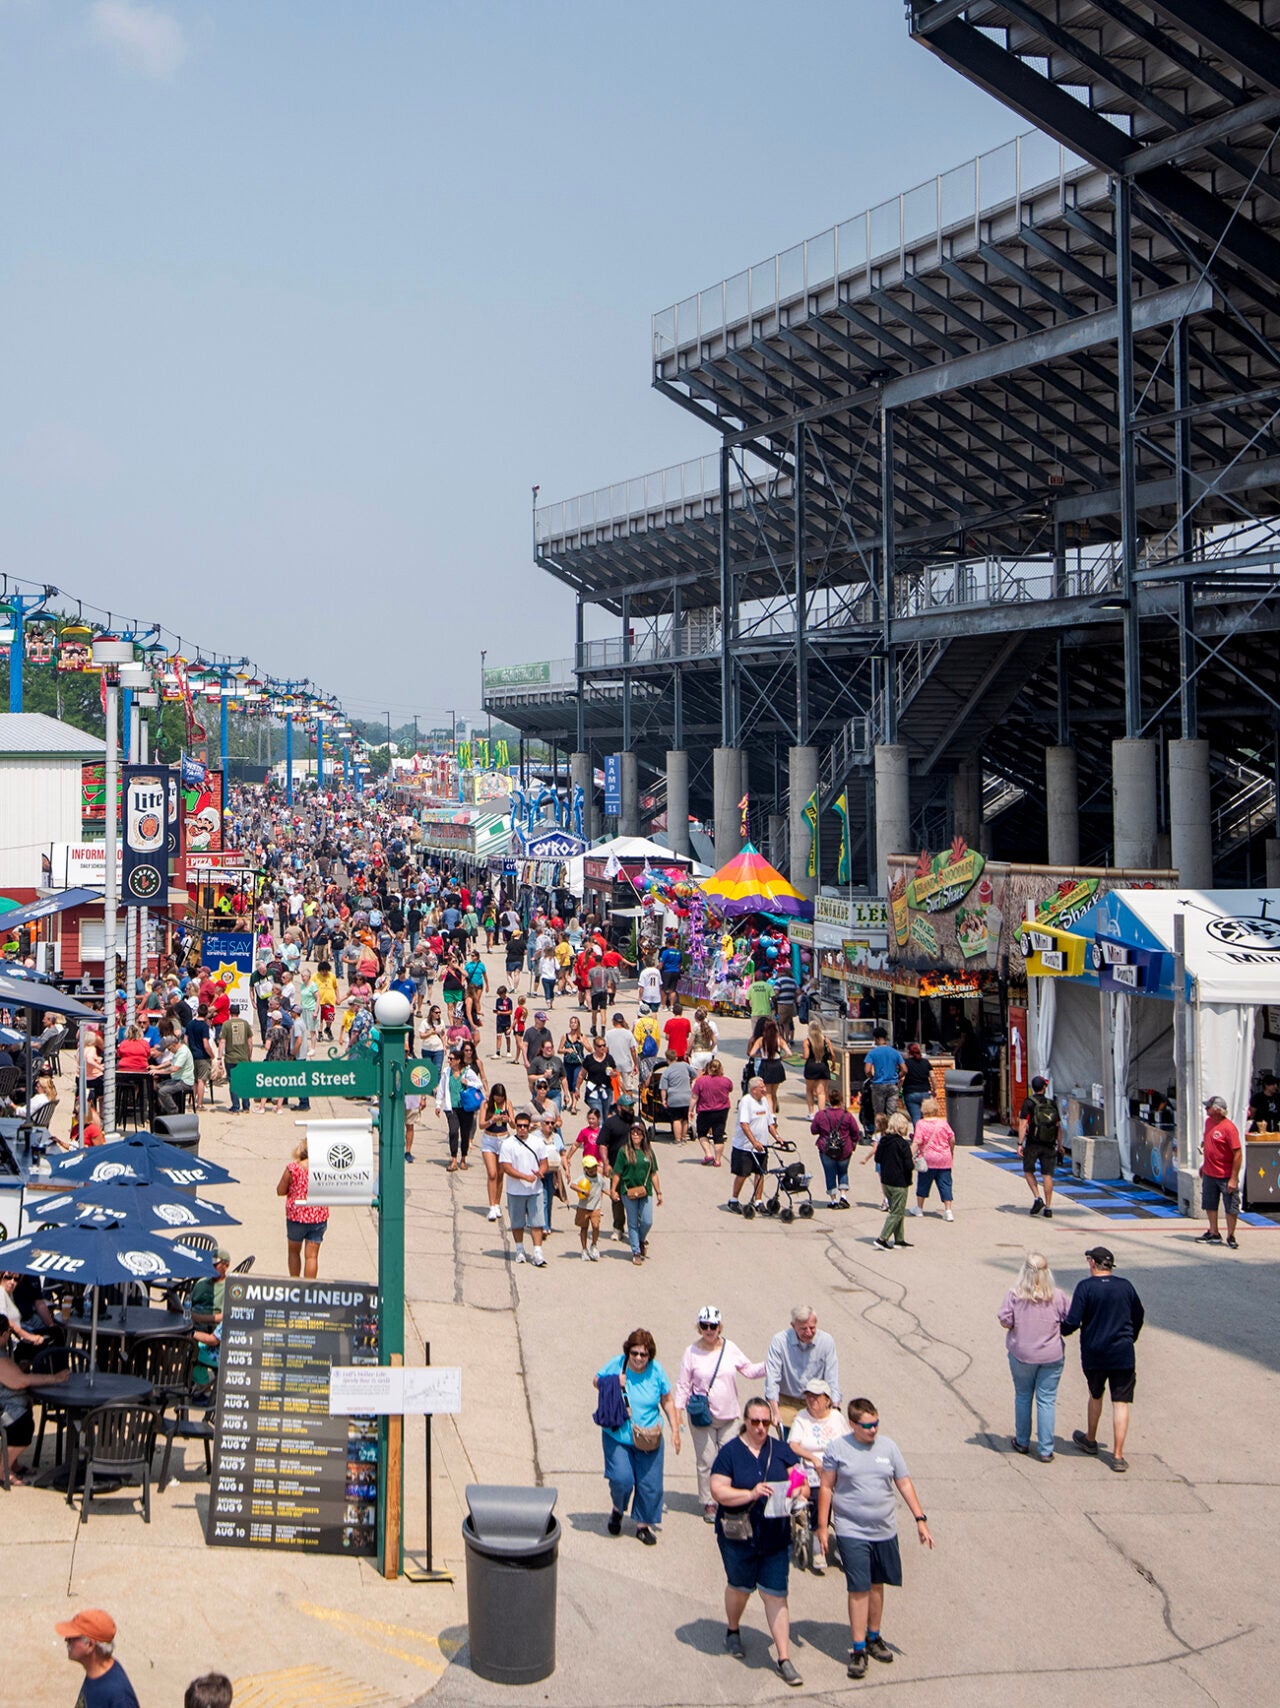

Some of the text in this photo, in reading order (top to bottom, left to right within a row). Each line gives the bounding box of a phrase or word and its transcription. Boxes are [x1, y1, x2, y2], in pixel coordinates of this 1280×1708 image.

[608, 758, 616, 792] RAMP
[134, 792, 162, 812] Lite
[72, 848, 123, 860] INFORMO
[532, 843, 579, 856] GYROS
[191, 858, 212, 866] PIZZA
[944, 861, 974, 880] NOODLES
[926, 884, 965, 914] Surf Shack
[1057, 886, 1088, 910] NOODLES
[816, 900, 849, 922] LEMONADE
[1060, 895, 1100, 929] Shack
[207, 941, 250, 952] SEE SAY
[650, 977, 656, 986] 11
[256, 1072, 356, 1087] Second Street
[165, 1167, 208, 1185] Lite
[312, 1171, 370, 1181] WISCONSIN
[26, 1252, 85, 1272] Lite
[246, 1285, 301, 1303] MUSIC
[304, 1290, 364, 1307] LINEUP
[230, 1311, 255, 1320] JUL 31
[228, 1336, 247, 1344] AUG
[227, 1356, 246, 1365] AUG
[247, 1357, 252, 1366] 2
[225, 1376, 251, 1386] AUG 3
[224, 1400, 242, 1408] AUG
[243, 1400, 249, 1409] 4
[222, 1420, 241, 1429] AUG
[242, 1421, 248, 1430] 5
[221, 1441, 240, 1449] AUG
[241, 1442, 247, 1450] 6
[220, 1461, 246, 1470] AUG 7
[218, 1483, 244, 1492] AUG 8
[216, 1504, 243, 1512] AUG 9
[215, 1528, 246, 1538] AUG 10
